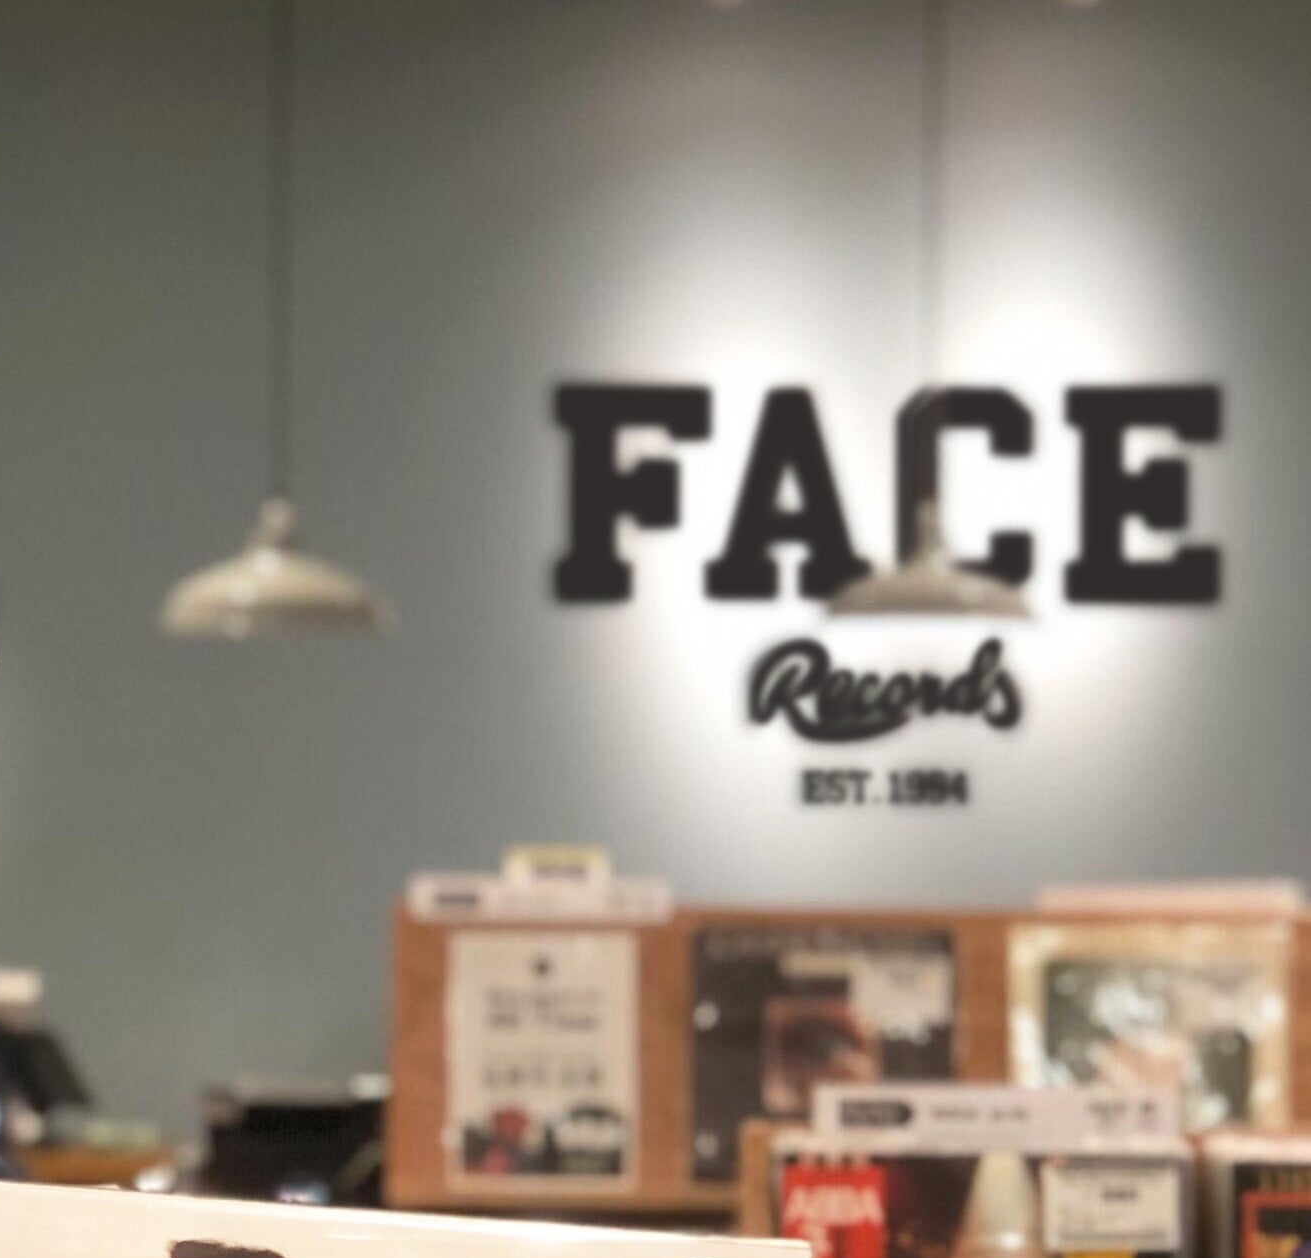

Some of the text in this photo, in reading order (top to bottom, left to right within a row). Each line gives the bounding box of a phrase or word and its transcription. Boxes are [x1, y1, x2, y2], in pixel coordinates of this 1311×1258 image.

[554, 384, 1222, 605] FACE
[748, 636, 1022, 743] Records
[801, 767, 969, 805] EST. 1994
